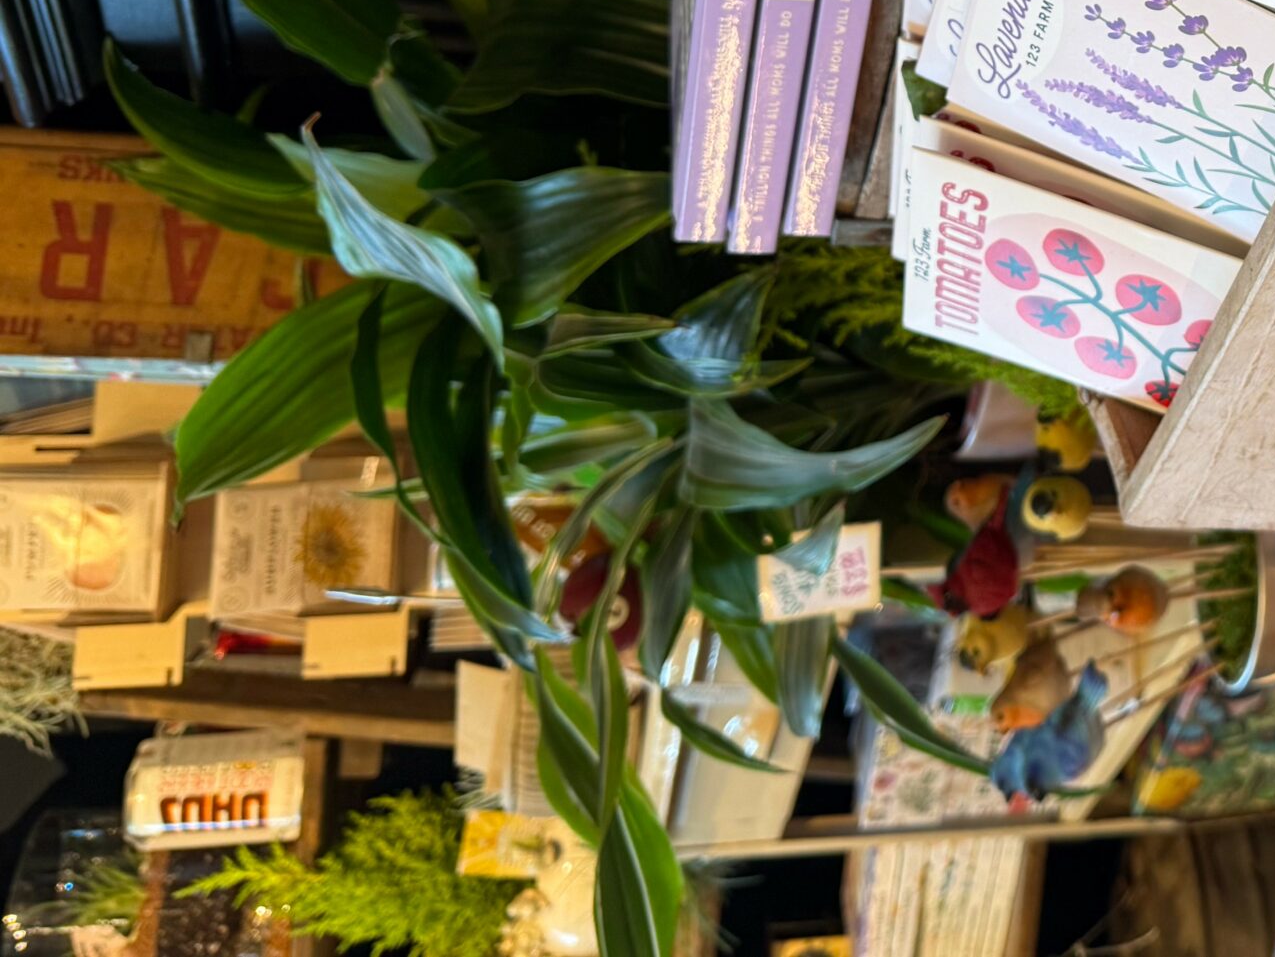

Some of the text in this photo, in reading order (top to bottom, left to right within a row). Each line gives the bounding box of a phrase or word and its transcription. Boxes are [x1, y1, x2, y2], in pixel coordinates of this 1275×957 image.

[780, 11, 792, 27] DO
[835, 6, 850, 35] WILL
[1026, 0, 1054, 68] 123 FARM
[776, 31, 790, 60] WILL
[829, 39, 845, 75] MOMS
[772, 63, 786, 96] MOMS
[825, 77, 839, 97] ALL
[769, 98, 780, 120] ALL
[761, 123, 777, 164] THINGS
[912, 228, 932, 282] 123 Farm
[934, 182, 989, 336] TOMATOES
